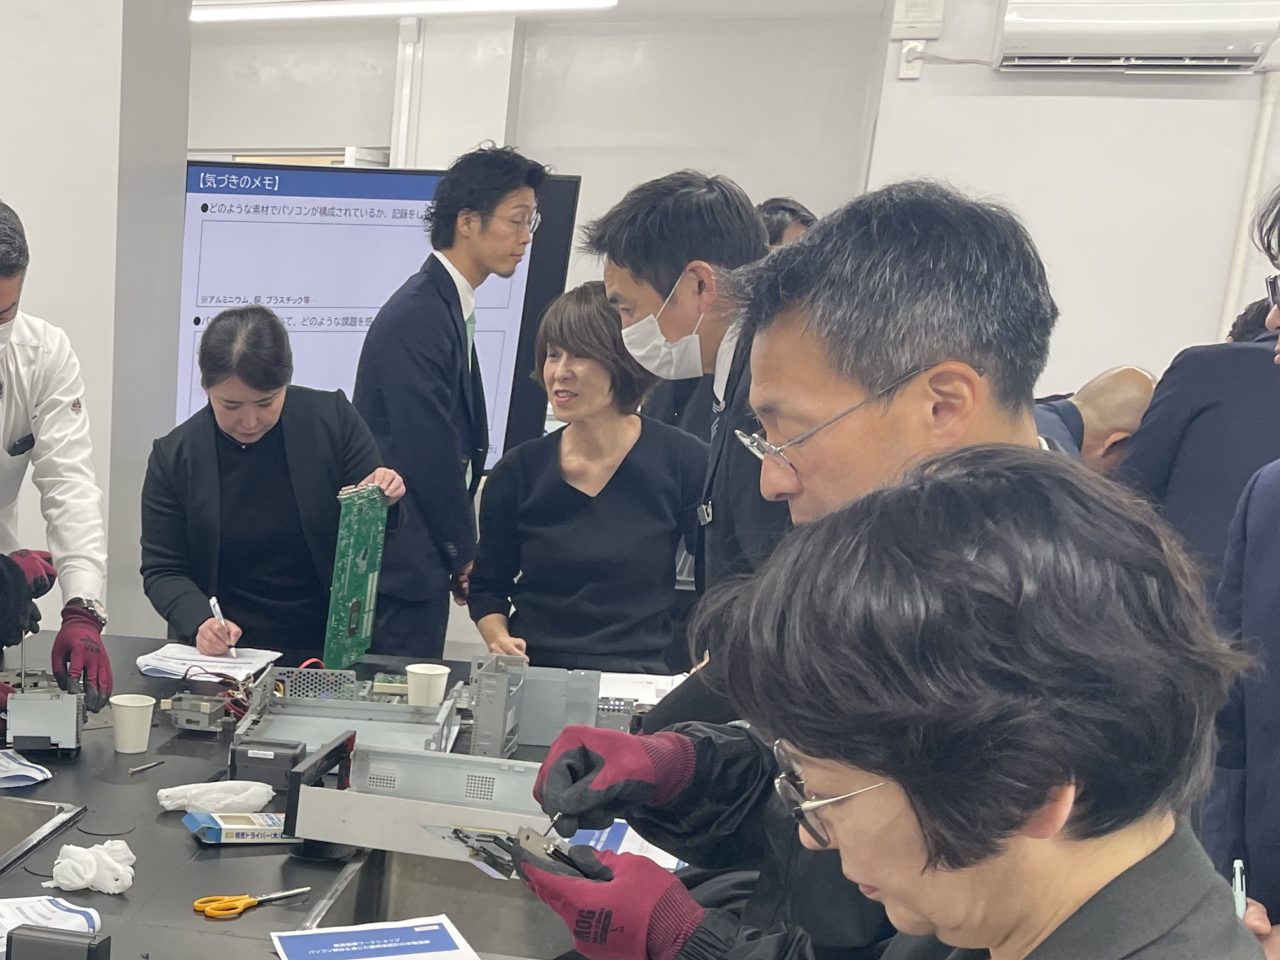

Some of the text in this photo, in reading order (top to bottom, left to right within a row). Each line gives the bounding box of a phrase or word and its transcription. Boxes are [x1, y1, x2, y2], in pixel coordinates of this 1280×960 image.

[199, 172, 279, 191] 【気づきのメモ】
